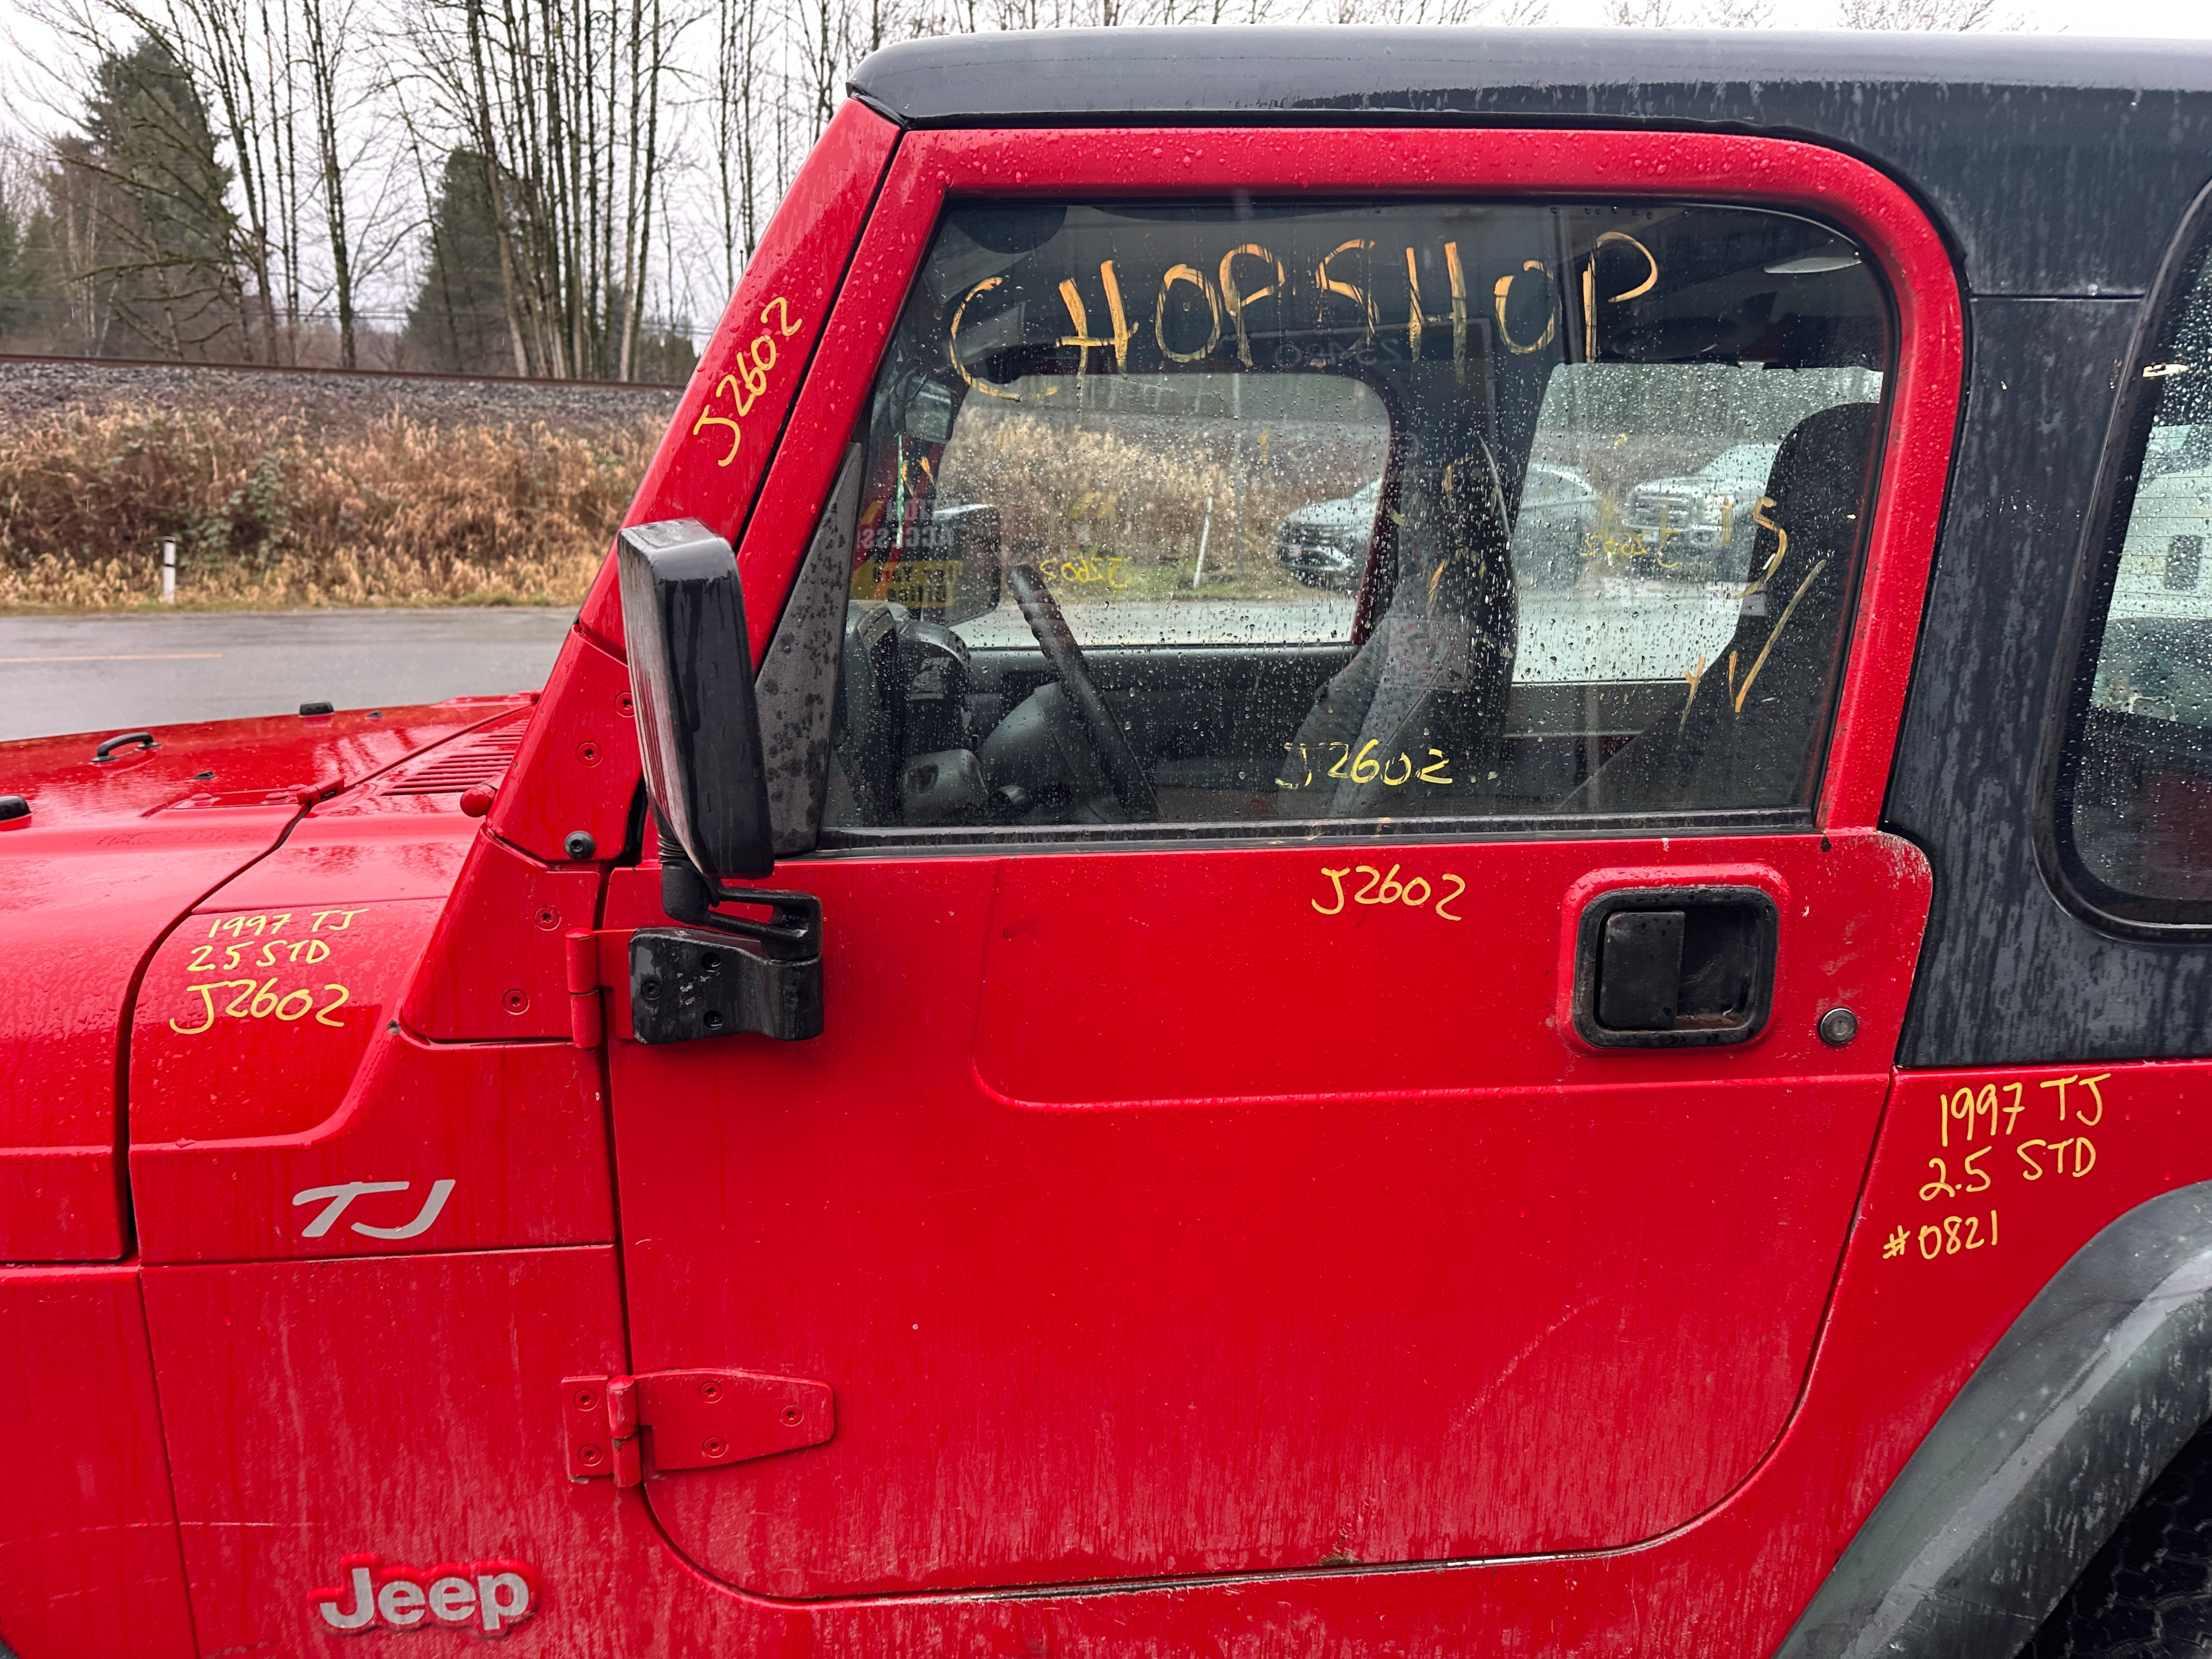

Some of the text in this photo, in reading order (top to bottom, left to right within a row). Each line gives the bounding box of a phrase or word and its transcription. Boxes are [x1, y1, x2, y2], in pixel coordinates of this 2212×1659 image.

[693, 296, 803, 467] J2602
[1275, 739, 1453, 789] J2602
[1311, 864, 1465, 921] J2602
[208, 908, 370, 938] 1997 TJ
[256, 940, 330, 967] STD
[169, 978, 350, 1034] J2602
[1940, 1073, 2111, 1147] 1997 TJ
[1919, 1137, 2096, 1201] 2.5 STD
[292, 1179, 456, 1240] TJ
[319, 1566, 531, 1631] Jeep
